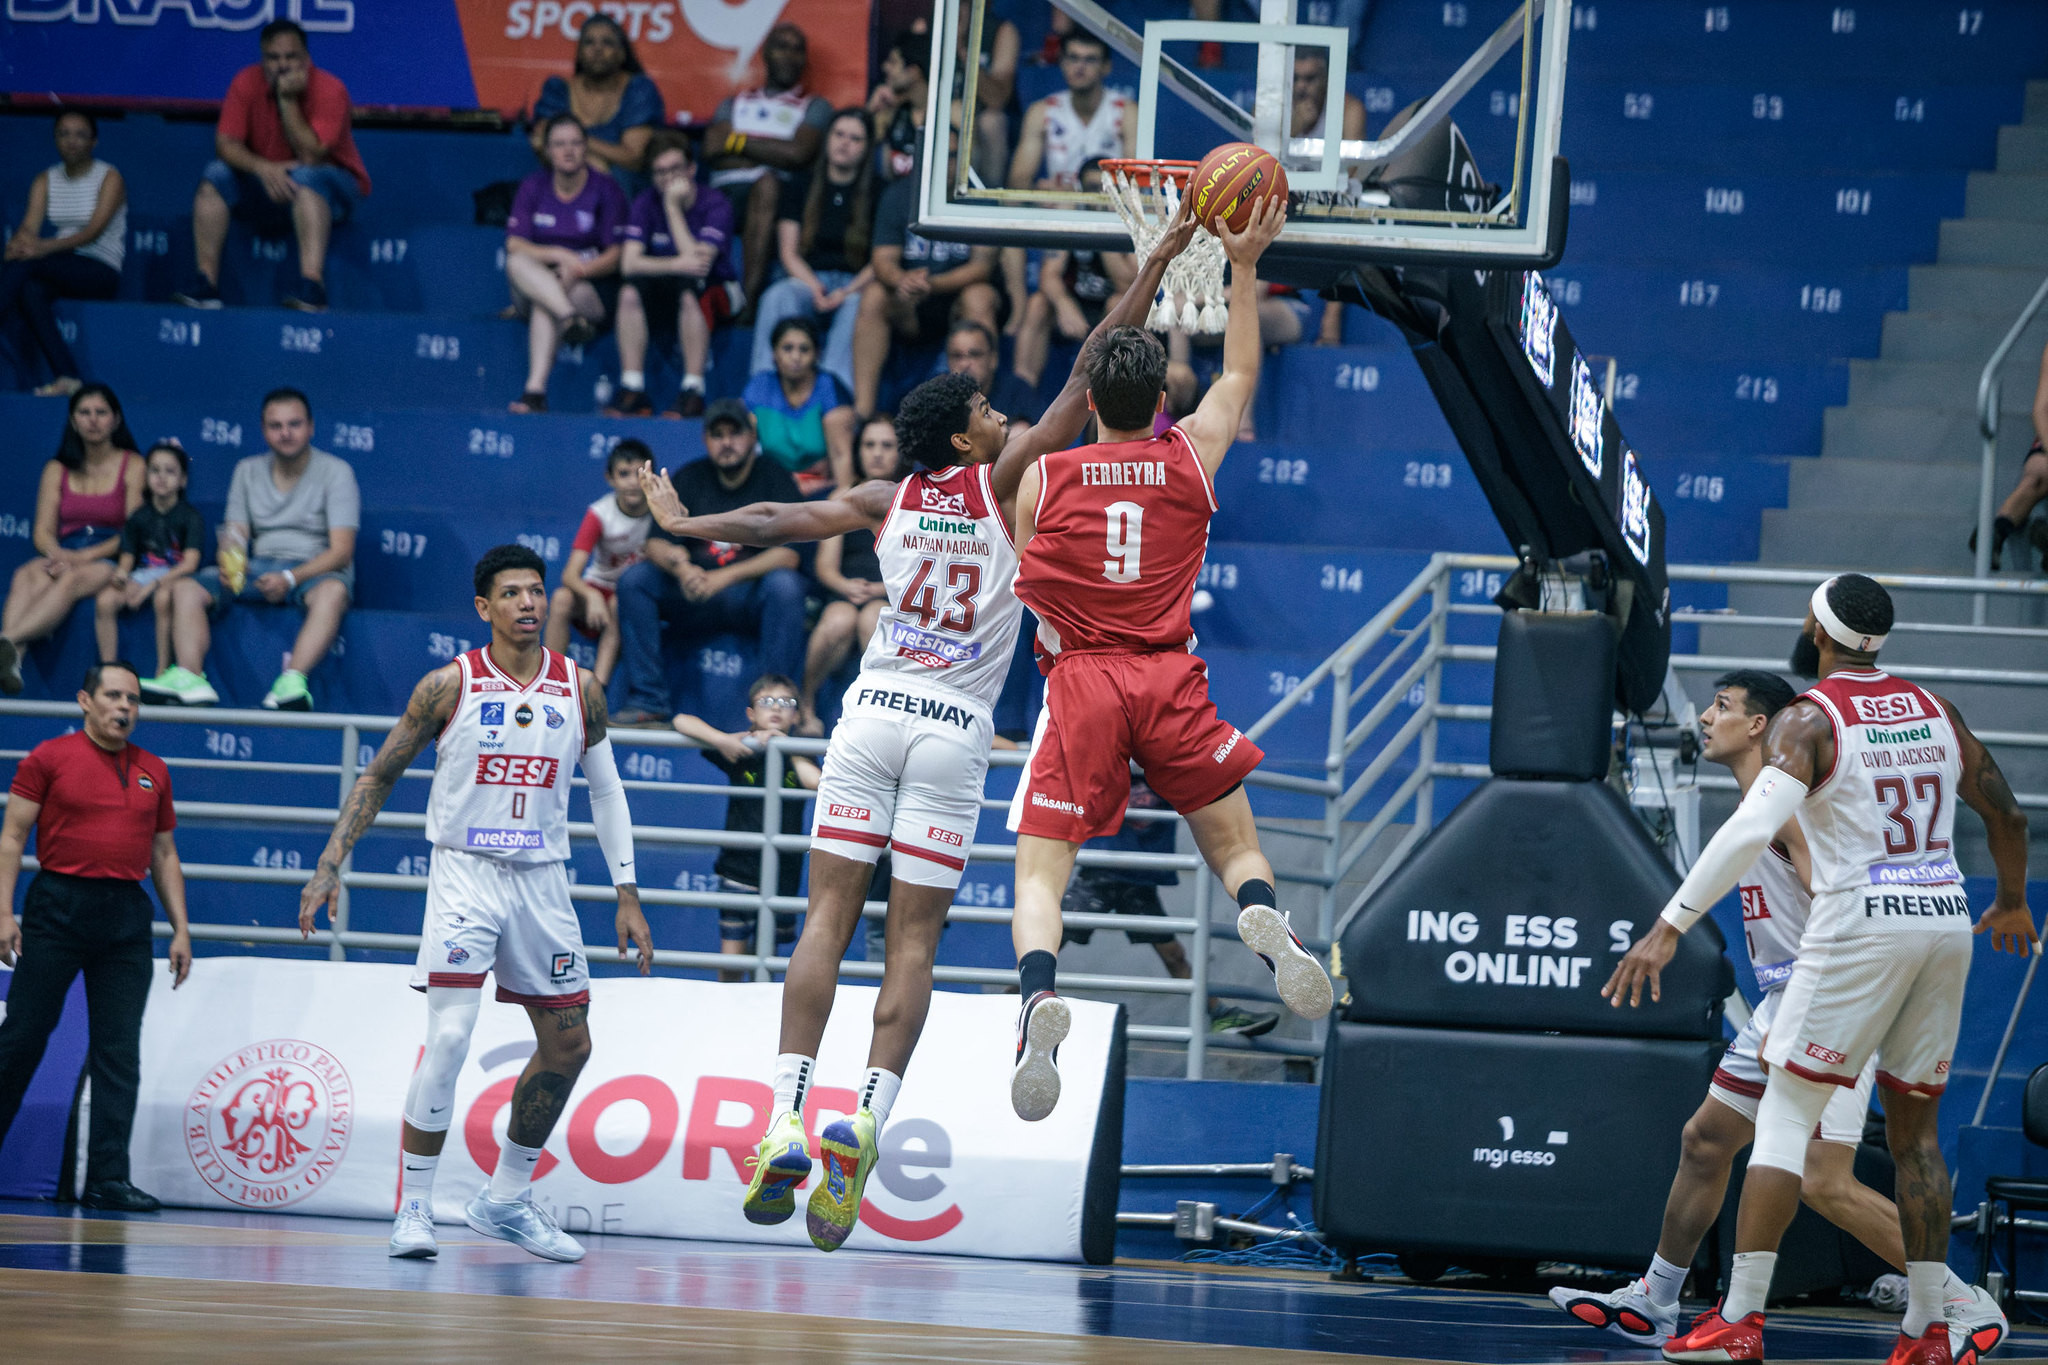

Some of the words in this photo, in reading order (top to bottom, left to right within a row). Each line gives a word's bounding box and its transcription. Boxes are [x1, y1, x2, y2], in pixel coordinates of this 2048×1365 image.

[1958, 10, 1984, 35] 17
[1196, 148, 1252, 218] PENALTY
[1242, 171, 1263, 199] OVER
[1705, 187, 1745, 214] 100
[1836, 188, 1872, 215] 101
[369, 239, 408, 263] 147
[1680, 281, 1720, 308] 157
[159, 317, 200, 347] 201
[280, 323, 323, 353] 202
[416, 333, 460, 361] 203
[1335, 363, 1380, 392] 210
[1735, 374, 1779, 403] 213
[202, 417, 243, 447] 254
[1081, 461, 1167, 486] FERREYRA
[0, 512, 30, 540] 04
[918, 515, 977, 536] Unimed
[381, 529, 428, 559] 307
[902, 534, 943, 553] NATHAN
[1101, 500, 1145, 583] 9
[1321, 564, 1364, 593] 314
[1460, 568, 1502, 599] 315
[897, 556, 983, 634] 43
[701, 647, 744, 679] 359
[857, 688, 975, 731] FREEWAY
[1861, 694, 1915, 719] SESI
[1214, 727, 1244, 765] BRASAN
[1865, 724, 1932, 745] Unimed
[624, 751, 673, 781] 406
[1860, 750, 1893, 768] DAVID
[1896, 745, 1947, 767] JACKSON
[484, 757, 552, 786] SESI
[512, 792, 527, 820] 0
[830, 805, 868, 819] FIESP
[1873, 771, 1952, 858] 32
[931, 828, 962, 846] SESI
[253, 845, 302, 870] 449
[395, 854, 430, 877] 45
[956, 881, 1007, 907] 454
[189, 1123, 226, 1184] CLUB
[304, 1053, 350, 1186] PAULISTANO
[239, 1183, 289, 1204] 1900
